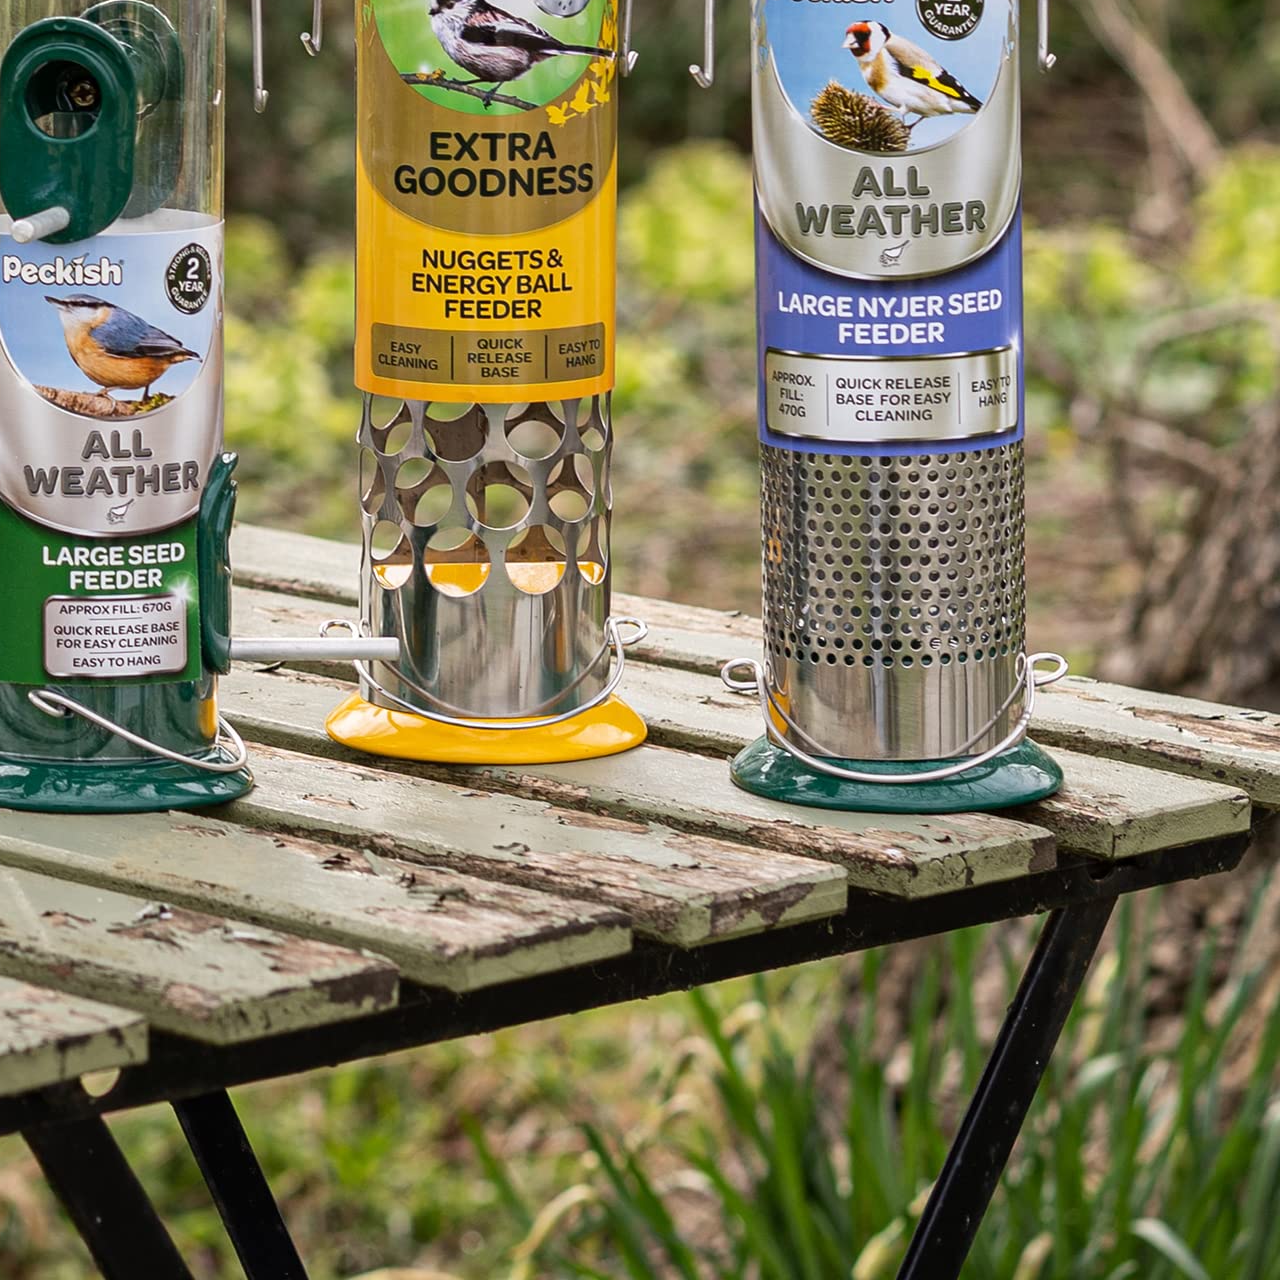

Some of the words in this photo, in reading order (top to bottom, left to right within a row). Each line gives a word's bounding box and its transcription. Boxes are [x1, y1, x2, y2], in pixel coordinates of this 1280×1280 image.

[934, 2, 970, 16] YEAR
[924, 9, 977, 35] GUARANTEE
[429, 131, 557, 161] EXTRA
[394, 163, 593, 198] GOODNESS
[851, 166, 930, 199] ALL
[795, 200, 986, 236] WEATHER
[422, 249, 543, 271] NUGGETS
[547, 248, 564, 268] &
[2, 252, 122, 286] Peckish
[186, 257, 199, 279] 2
[178, 280, 204, 292] YEAR
[411, 273, 512, 295] ENERGY
[516, 272, 573, 295] BALL
[444, 299, 542, 320] FEEDER
[778, 291, 853, 318] LARGE
[858, 296, 944, 318] NYJER
[948, 289, 1002, 314] SEED
[838, 322, 944, 345] FEEDER
[391, 341, 422, 355] EASY
[477, 338, 523, 350] QUICK
[558, 341, 588, 355] EASY
[588, 338, 600, 350] TO
[378, 353, 438, 371] CLEANING
[467, 351, 532, 364] RELEASE
[566, 354, 596, 368] HANG
[480, 366, 519, 378] BASE
[772, 371, 815, 387] APPROX.
[836, 378, 881, 390] QUICK
[885, 376, 951, 389] RELEASE
[971, 380, 999, 392] EASY
[999, 376, 1010, 387] TO
[780, 389, 804, 401] FILL:
[836, 394, 873, 406] BASE
[880, 393, 910, 405] FOR
[914, 392, 951, 404] EASY
[979, 393, 1007, 407] HANG
[779, 403, 806, 417] 470G
[855, 409, 932, 422] CLEANING
[81, 429, 152, 461] ALL
[24, 461, 199, 497] WEATHER
[42, 546, 125, 566] LARGE
[128, 542, 185, 565] SEED
[69, 568, 163, 590] FEEDER
[59, 604, 109, 616] APPROX
[112, 603, 140, 614] FILL:
[142, 602, 172, 613] 670G
[53, 625, 92, 636] QUICK
[95, 623, 149, 635] RELEASE
[151, 621, 179, 633] BASE
[56, 639, 80, 649] FOR
[83, 638, 116, 649] EASY
[119, 635, 178, 648] CLEANING
[72, 657, 104, 668] EASY
[105, 656, 125, 667] TO
[127, 655, 161, 666] HANG
